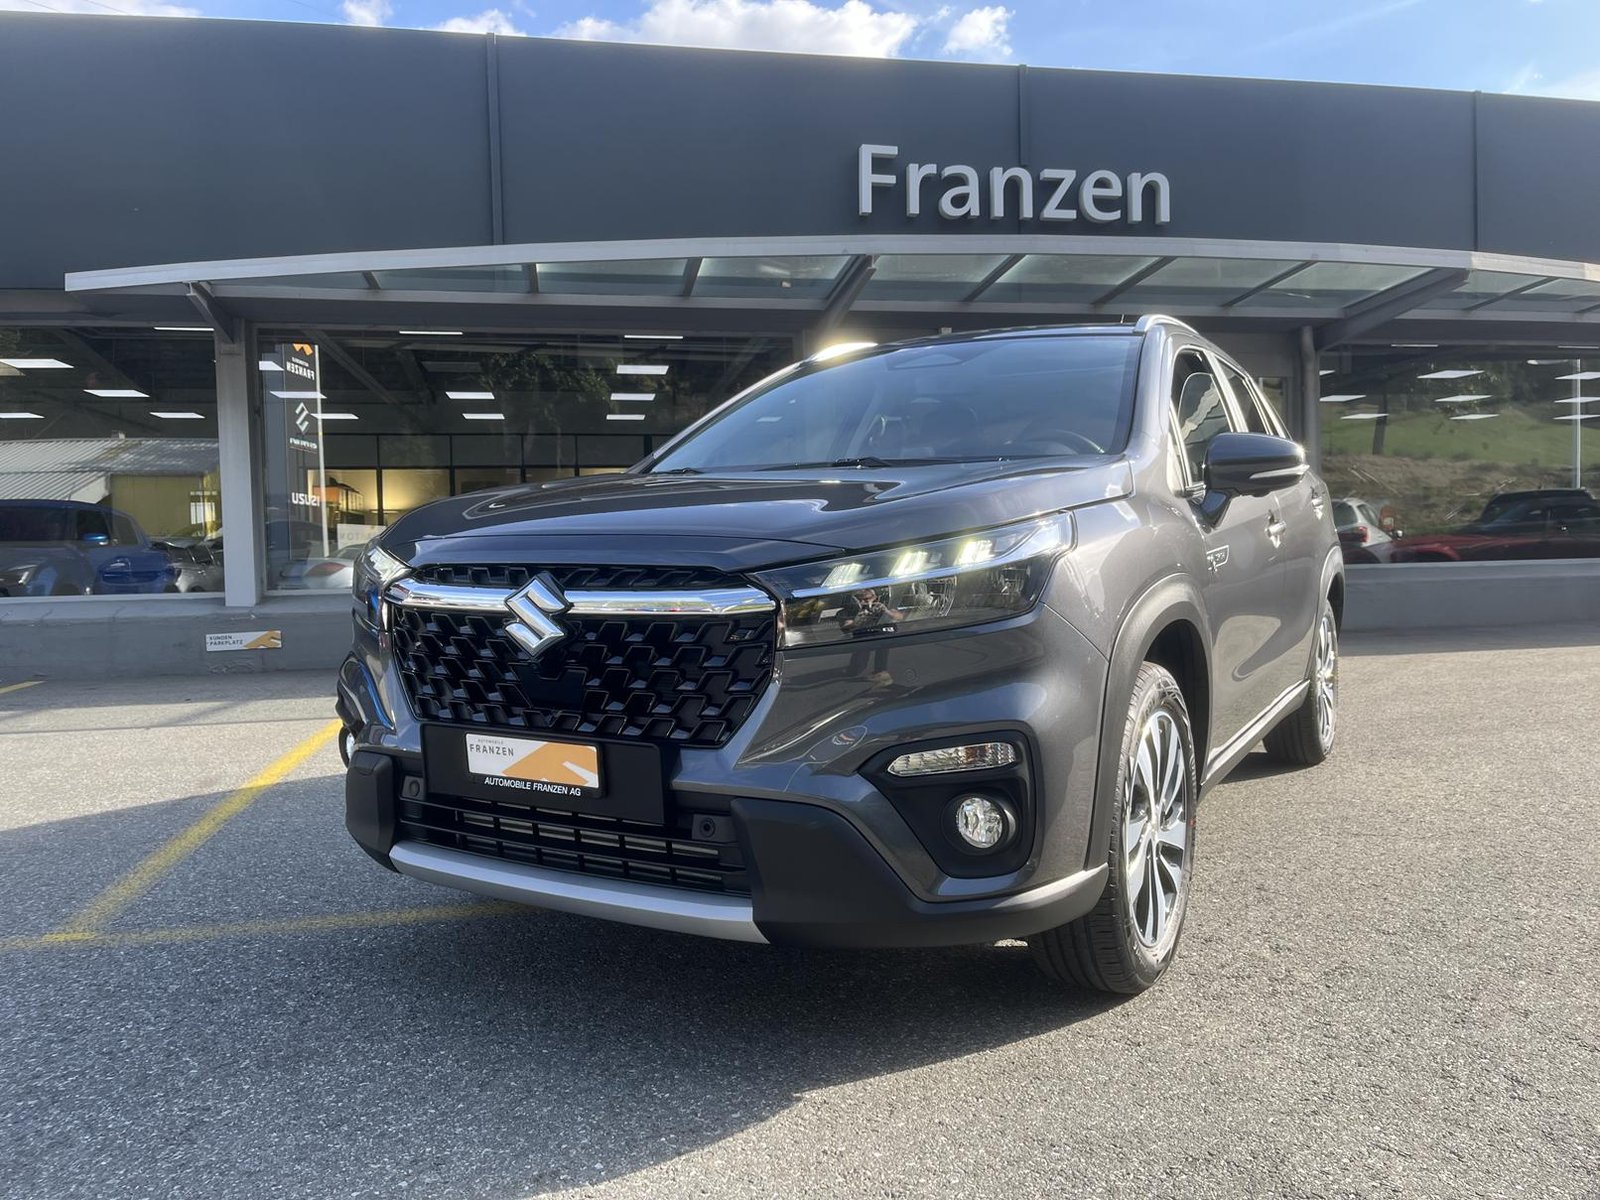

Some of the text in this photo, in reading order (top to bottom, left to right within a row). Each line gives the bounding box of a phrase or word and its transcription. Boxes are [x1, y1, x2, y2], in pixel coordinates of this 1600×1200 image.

[858, 144, 1171, 224] Franzen
[469, 743, 514, 757] FRANZEN
[484, 777, 581, 797] AUTOMOBILE FRANZEN AG
